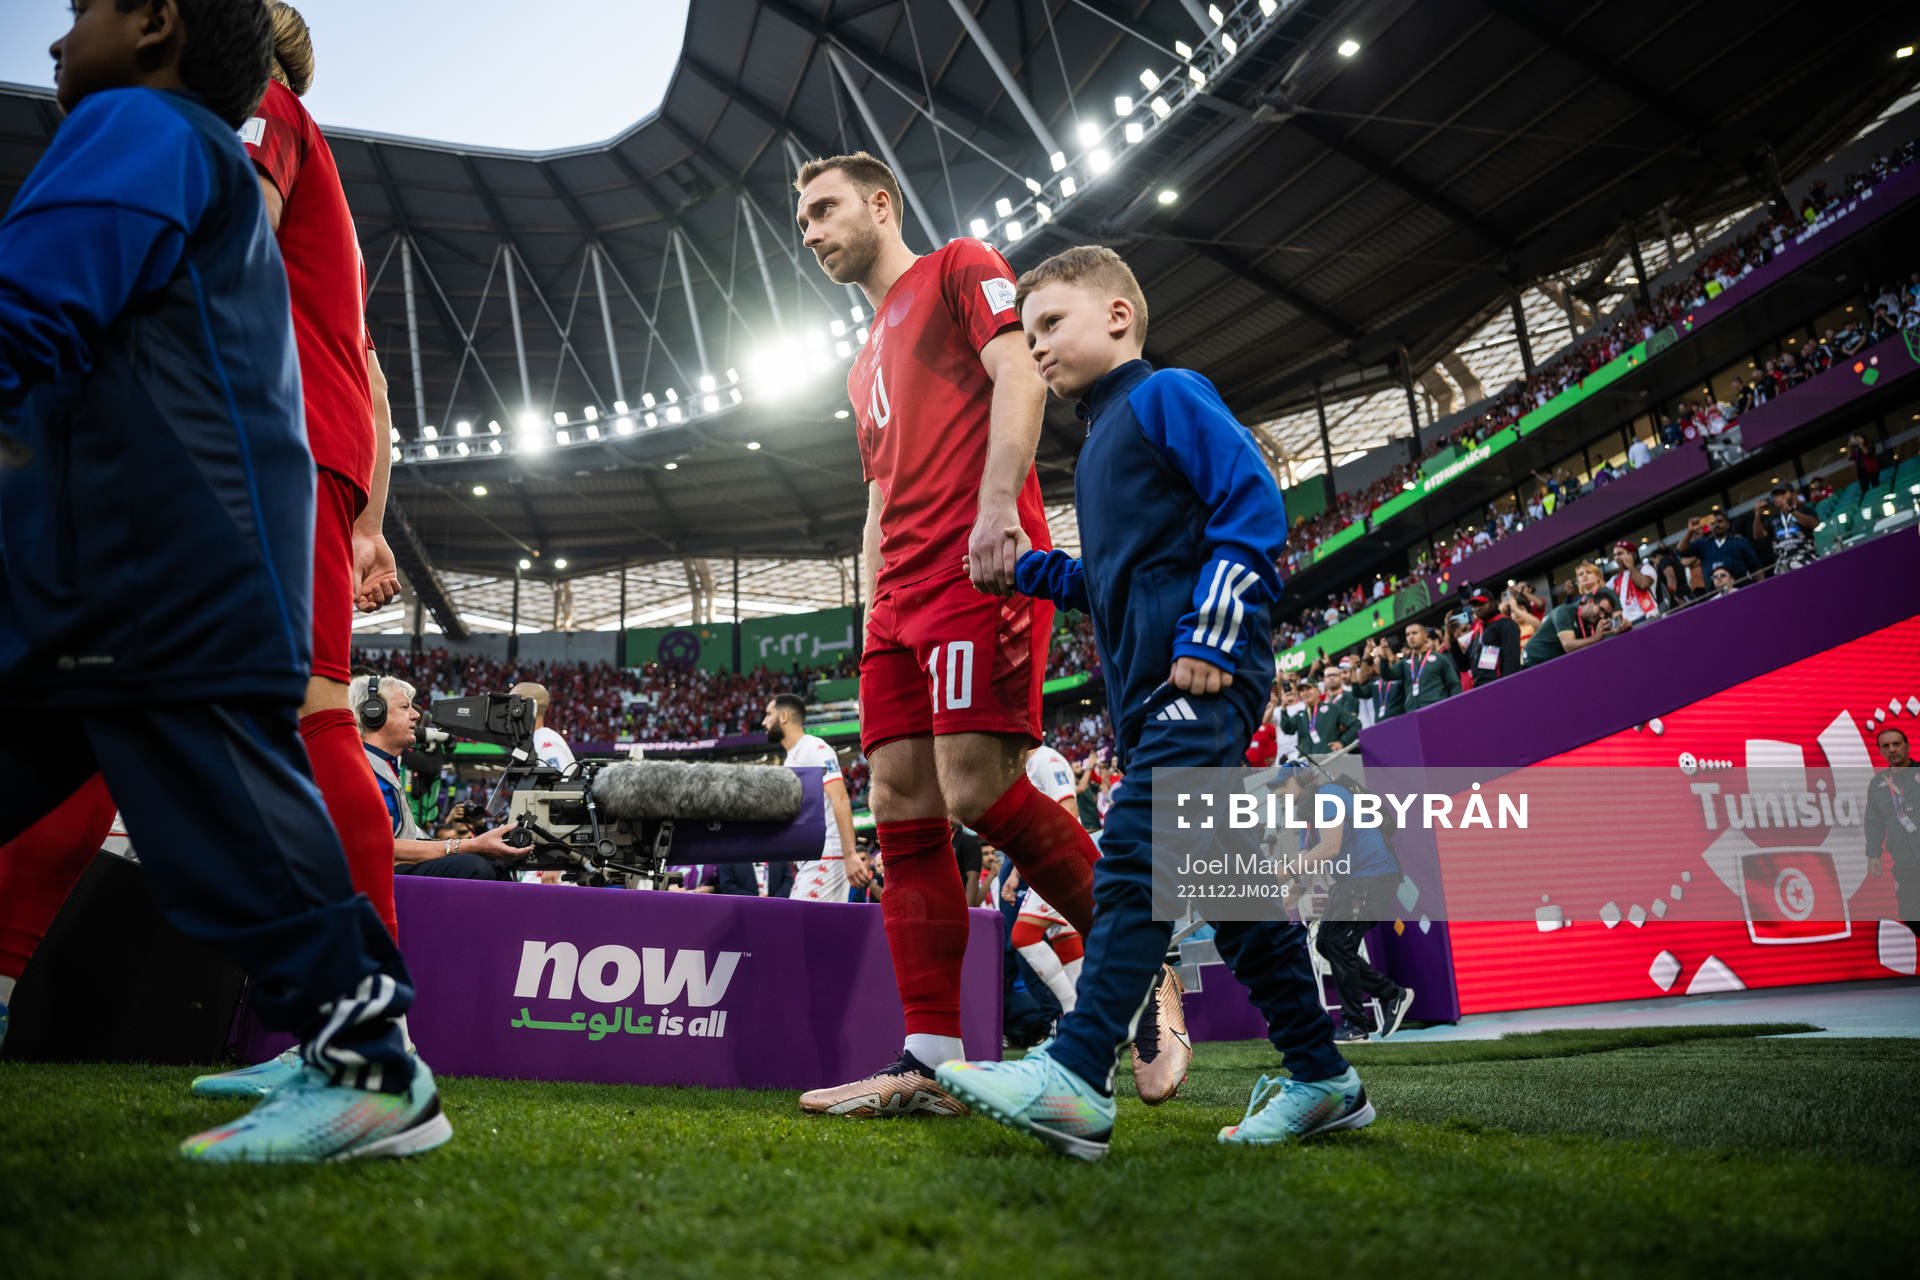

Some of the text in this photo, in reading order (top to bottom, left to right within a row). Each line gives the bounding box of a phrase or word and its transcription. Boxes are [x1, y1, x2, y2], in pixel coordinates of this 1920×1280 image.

[868, 366, 890, 429] 0
[928, 641, 974, 714] 10
[1690, 779, 1861, 830] Tunisia
[658, 1007, 728, 1038] is all
